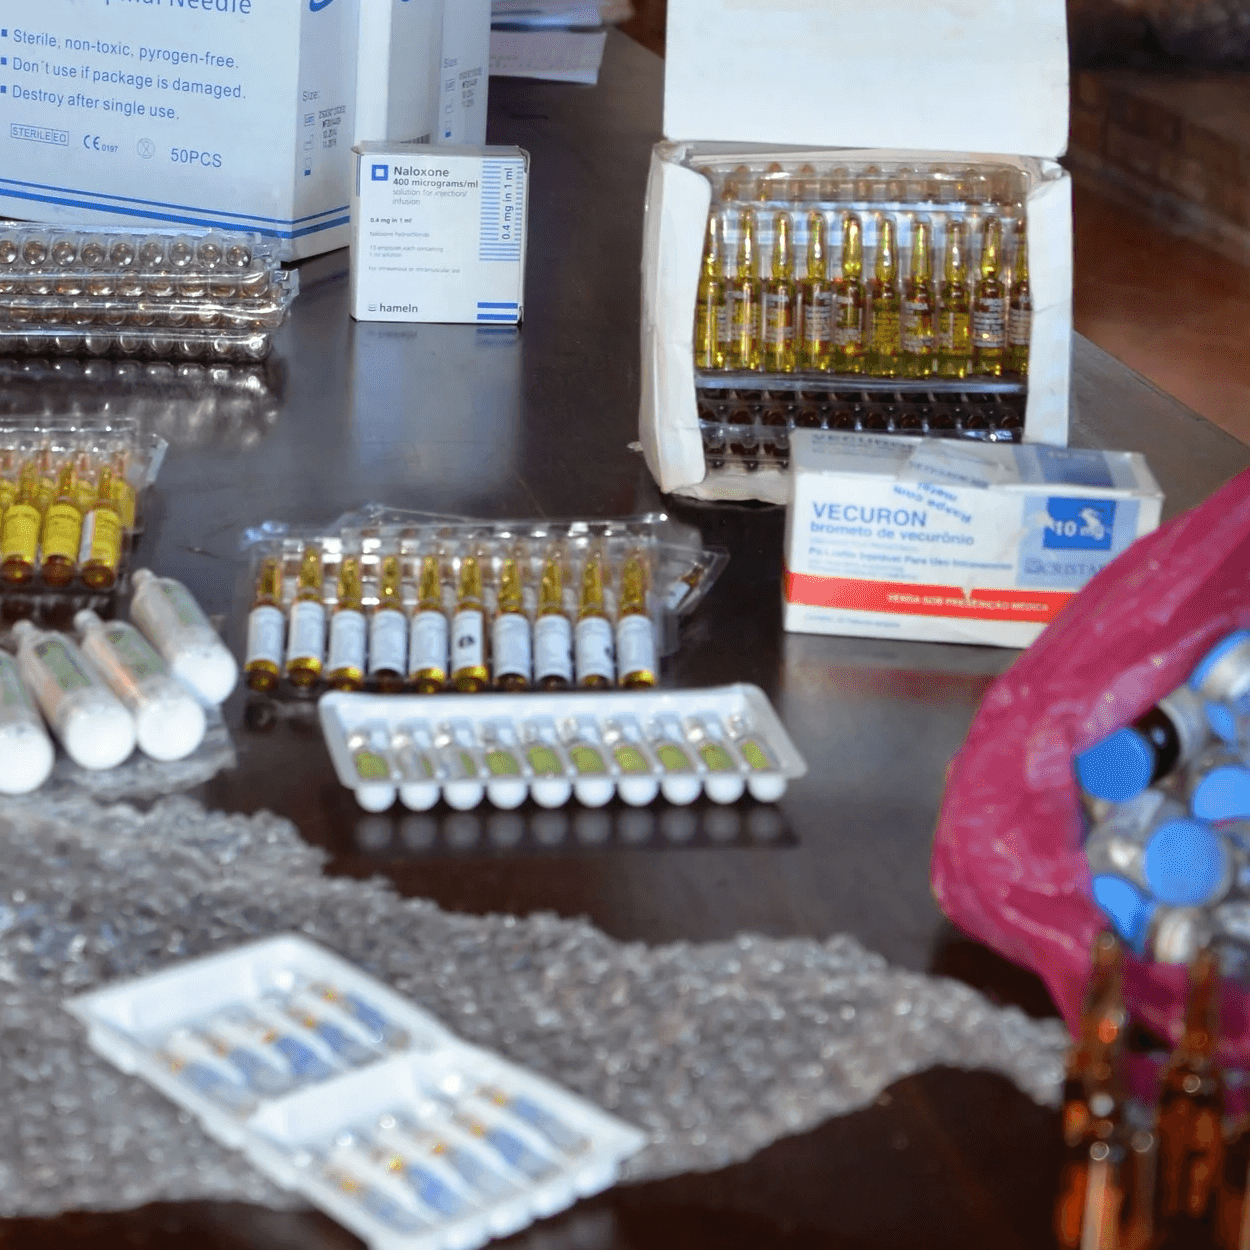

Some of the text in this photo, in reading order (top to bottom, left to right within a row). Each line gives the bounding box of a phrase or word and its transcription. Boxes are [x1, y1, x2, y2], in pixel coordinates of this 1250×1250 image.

[12, 28, 240, 70] Sterile, non-toxic, pyrogen-free.
[53, 63, 78, 78] use
[80, 65, 90, 80] if
[92, 69, 154, 90] package
[156, 74, 169, 90] is
[172, 76, 247, 100] damaged.
[12, 84, 181, 121] Destroy after single use.
[11, 125, 68, 144] STERILE EO
[170, 147, 223, 169] 50PCS
[393, 166, 450, 178] Naloxone
[503, 167, 513, 181] ml
[393, 178, 479, 189] 400 micrograms/ml
[392, 188, 421, 197] solution
[422, 189, 433, 197] for
[502, 192, 512, 203] in
[392, 198, 421, 206] infusion
[503, 205, 514, 222] mg
[501, 225, 512, 240] 0.4
[379, 302, 419, 314] hameln
[812, 502, 928, 528] VECURON
[810, 520, 872, 538] brometo
[876, 526, 895, 539] de
[900, 528, 975, 547] vecurônio
